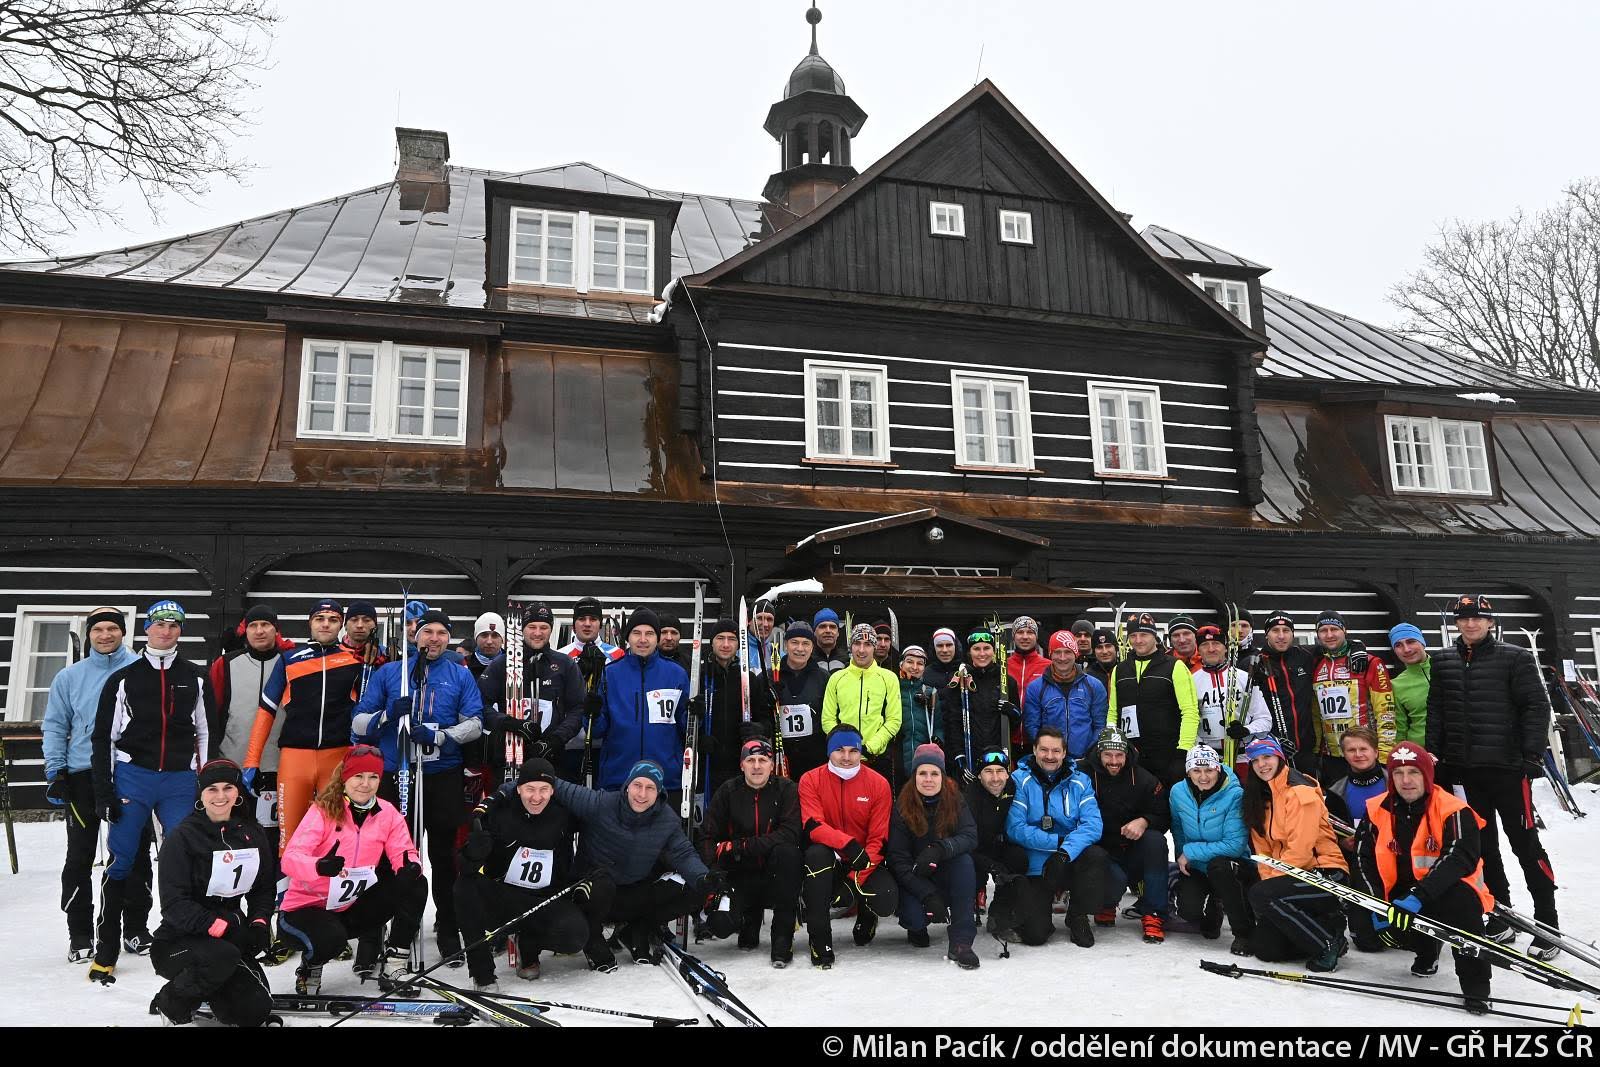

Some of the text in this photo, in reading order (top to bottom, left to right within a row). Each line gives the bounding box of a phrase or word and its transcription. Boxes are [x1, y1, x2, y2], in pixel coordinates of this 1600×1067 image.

[506, 616, 515, 680] ATOMIC
[515, 617, 524, 681] ATOMIC
[657, 699, 675, 719] 19
[1321, 696, 1348, 715] 102
[786, 714, 805, 733] 13
[232, 864, 244, 890] 1
[519, 860, 544, 884] 18
[1264, 858, 1367, 903] SPORTEN
[338, 879, 368, 903] 24
